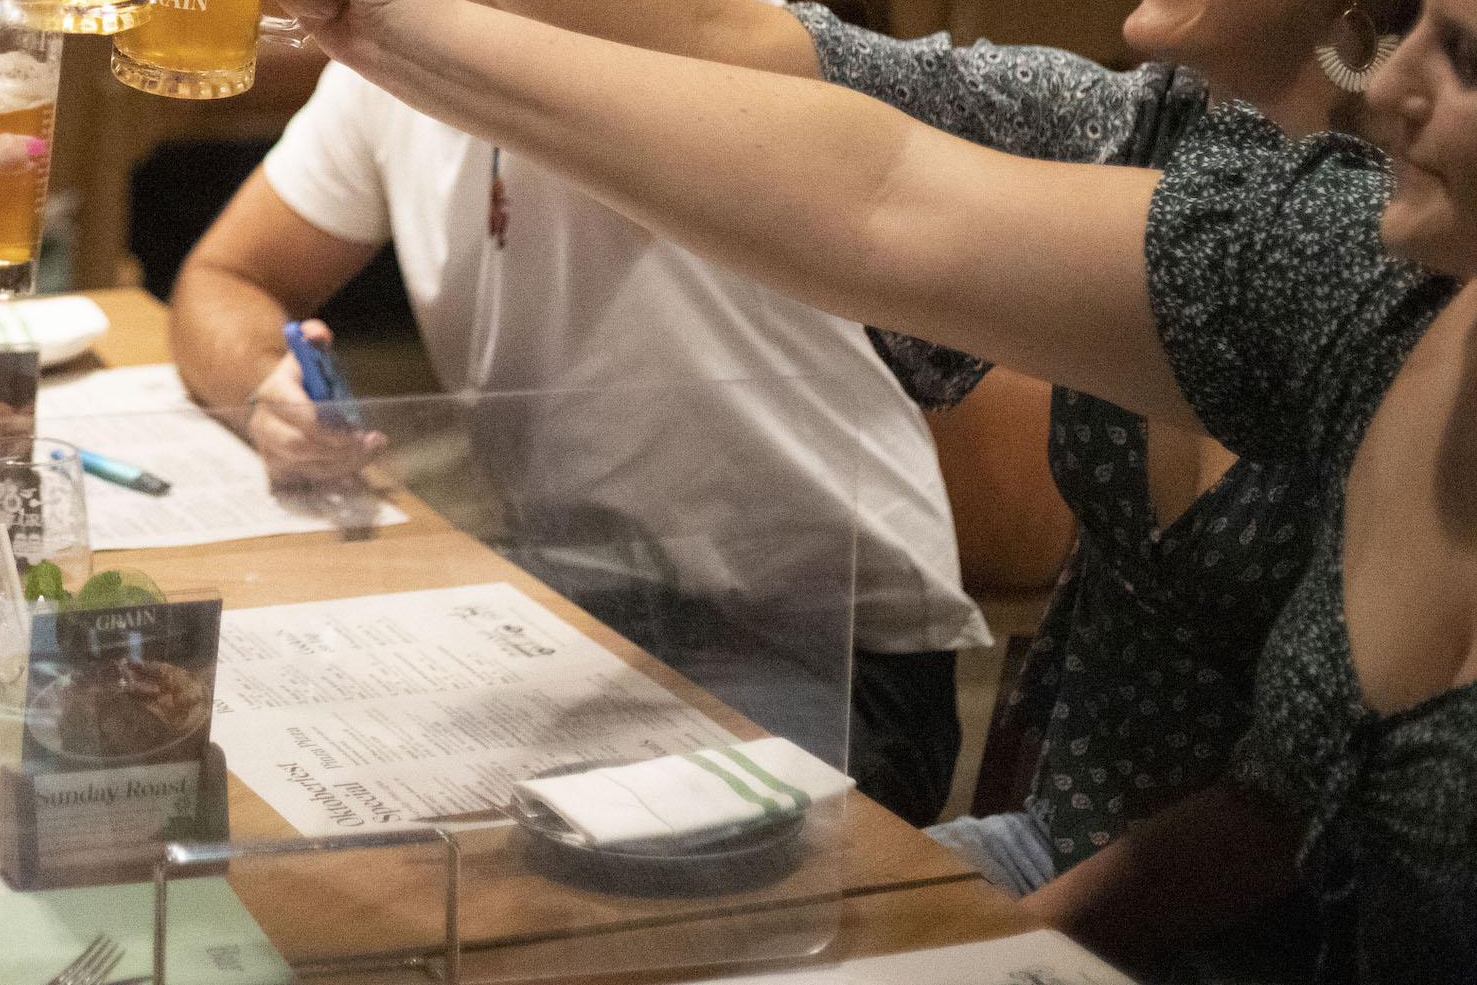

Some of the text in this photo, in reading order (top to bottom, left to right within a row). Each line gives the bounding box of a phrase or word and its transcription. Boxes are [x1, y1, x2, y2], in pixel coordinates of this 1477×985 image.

[95, 608, 157, 631] GRAIN
[36, 777, 189, 805] Sunday Roast
[276, 762, 365, 827] Oktoberfest
[332, 782, 402, 823] Special
